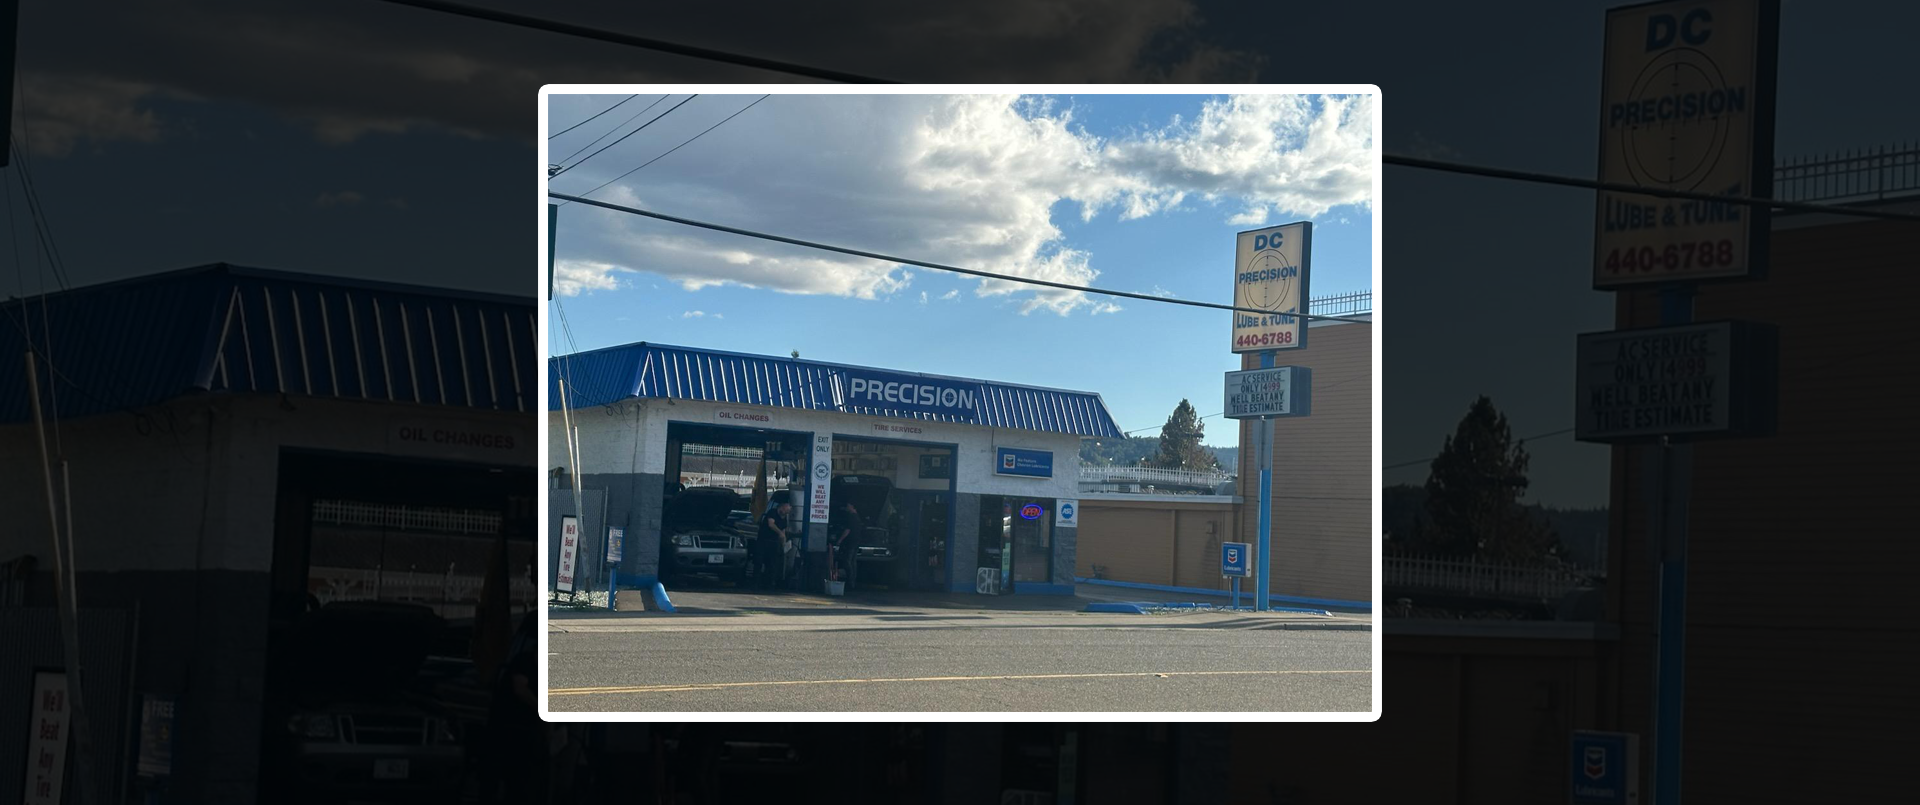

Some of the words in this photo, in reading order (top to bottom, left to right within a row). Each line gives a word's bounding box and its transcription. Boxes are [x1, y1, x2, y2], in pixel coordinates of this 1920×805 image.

[1645, 8, 1713, 53] DC
[1609, 86, 1745, 128] PRECISION
[1605, 196, 1656, 232] LUBE
[1662, 205, 1678, 226] &
[1681, 183, 1741, 227] TUNE
[1254, 232, 1283, 252] DC
[1606, 239, 1733, 274] 440-6788
[1239, 266, 1297, 284] PRECISION
[1236, 313, 1259, 329] LUBE
[1261, 317, 1268, 326] &
[1269, 308, 1295, 326] TUNE
[1237, 331, 1292, 346] 440-6788
[1618, 341, 1638, 361] AC
[1641, 333, 1708, 358] SERVICE
[1242, 375, 1251, 384] AC
[1253, 372, 1281, 383] SERVICE
[1615, 361, 1656, 383] ONLY
[850, 378, 973, 409] PRECISION
[1241, 383, 1258, 393] ONLY
[1639, 382, 1678, 404] BEAT
[1681, 379, 1714, 402] ANY
[719, 412, 733, 420] OIL
[734, 413, 769, 422] CHANGES
[1250, 402, 1283, 413] ESTIMATE
[1635, 404, 1713, 428] ESTIMATE
[399, 427, 427, 442] OIL
[433, 430, 515, 449] CHANGES
[874, 424, 889, 432] TIRE
[891, 425, 922, 434] SERVICES
[1023, 507, 1041, 517] OPEN
[152, 701, 175, 718] FREE
[40, 718, 59, 741] Beat
[39, 746, 55, 774] Any
